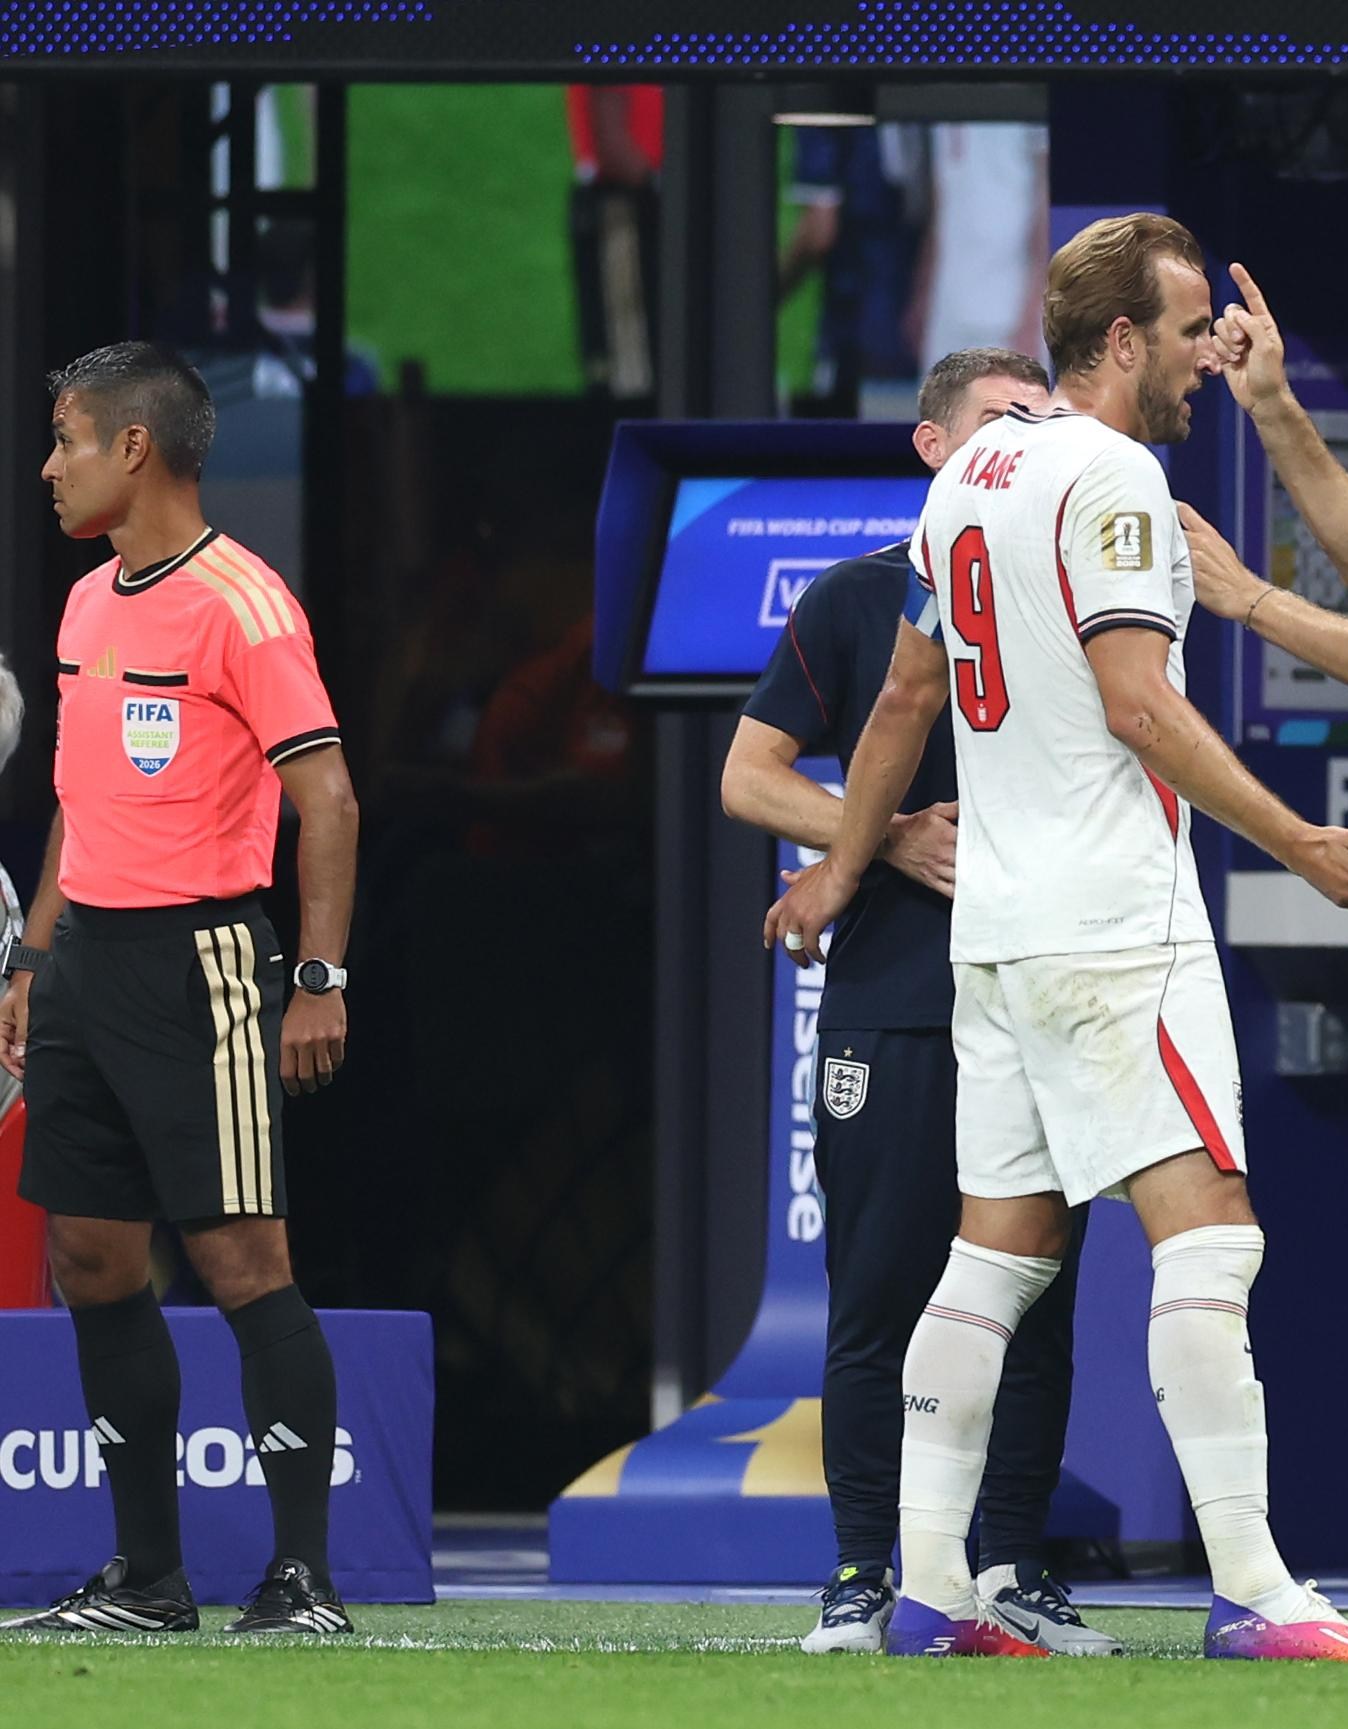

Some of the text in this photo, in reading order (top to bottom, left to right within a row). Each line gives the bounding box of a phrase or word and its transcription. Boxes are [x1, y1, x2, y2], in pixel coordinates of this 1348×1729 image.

[951, 525, 1010, 732] 9
[126, 703, 173, 721] FIFA
[127, 730, 174, 739] ASSISTANT
[139, 759, 161, 769] 2026
